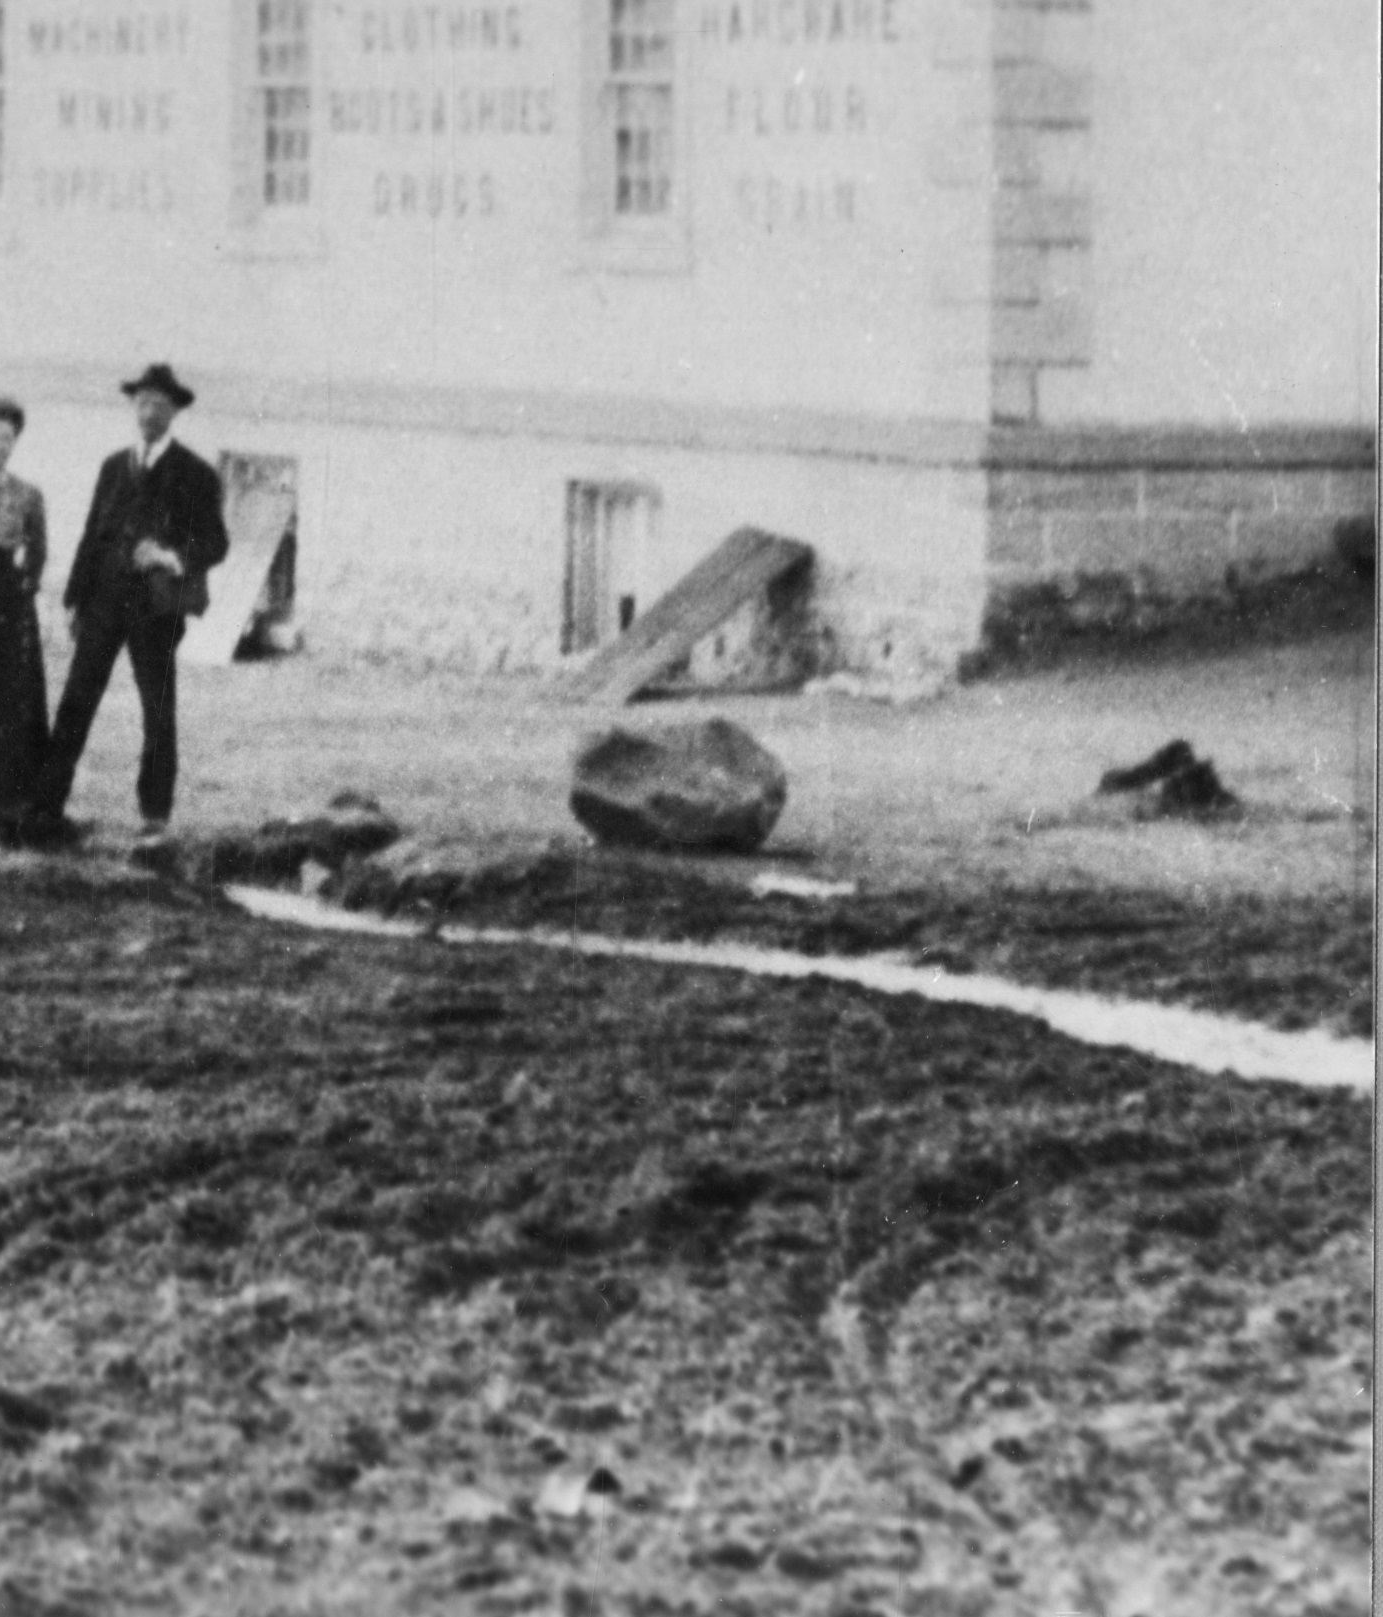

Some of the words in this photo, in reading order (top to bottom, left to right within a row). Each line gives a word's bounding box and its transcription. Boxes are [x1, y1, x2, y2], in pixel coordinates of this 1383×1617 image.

[28, 12, 190, 58] MACHINERY
[361, 4, 525, 55] CLOTHING
[57, 88, 174, 134] MINING
[725, 83, 868, 138] FLOUR
[372, 168, 497, 220] DRUGS
